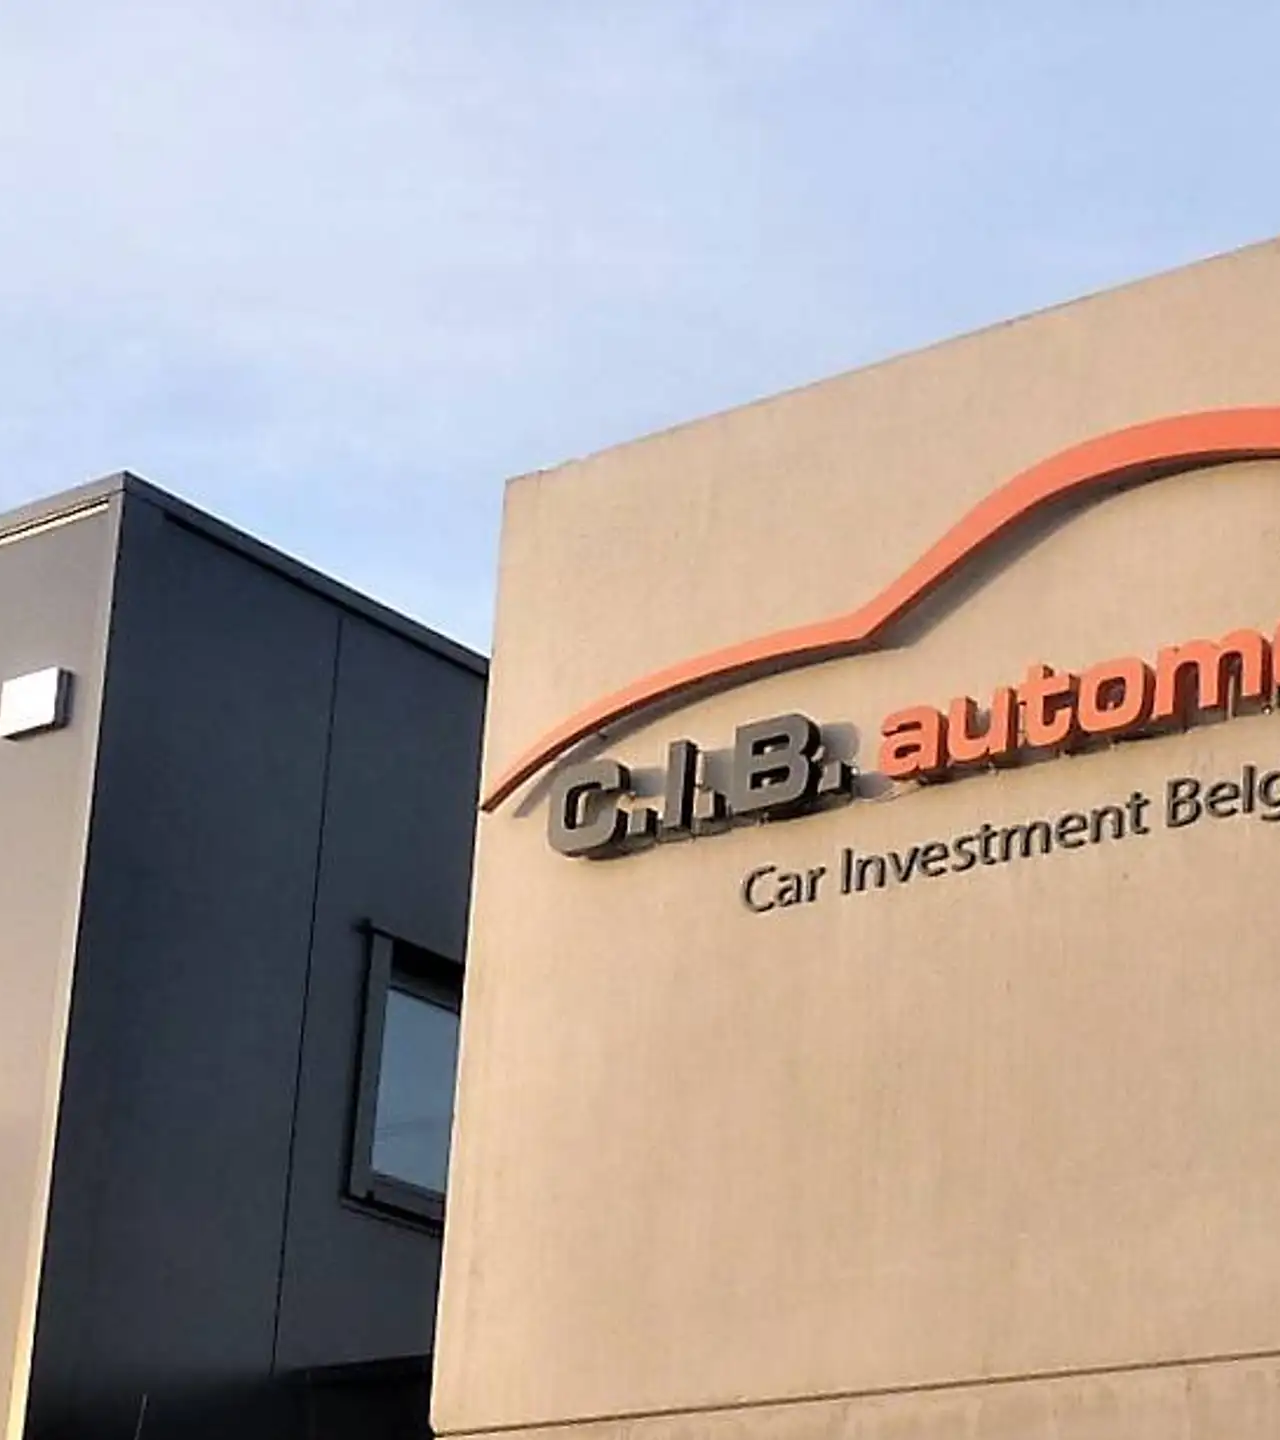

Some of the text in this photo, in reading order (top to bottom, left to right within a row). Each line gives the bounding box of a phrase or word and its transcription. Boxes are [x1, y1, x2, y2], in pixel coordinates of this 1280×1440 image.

[548, 713, 853, 858] C.I.B.
[741, 863, 827, 914] Car
[841, 791, 1151, 895] Investment
